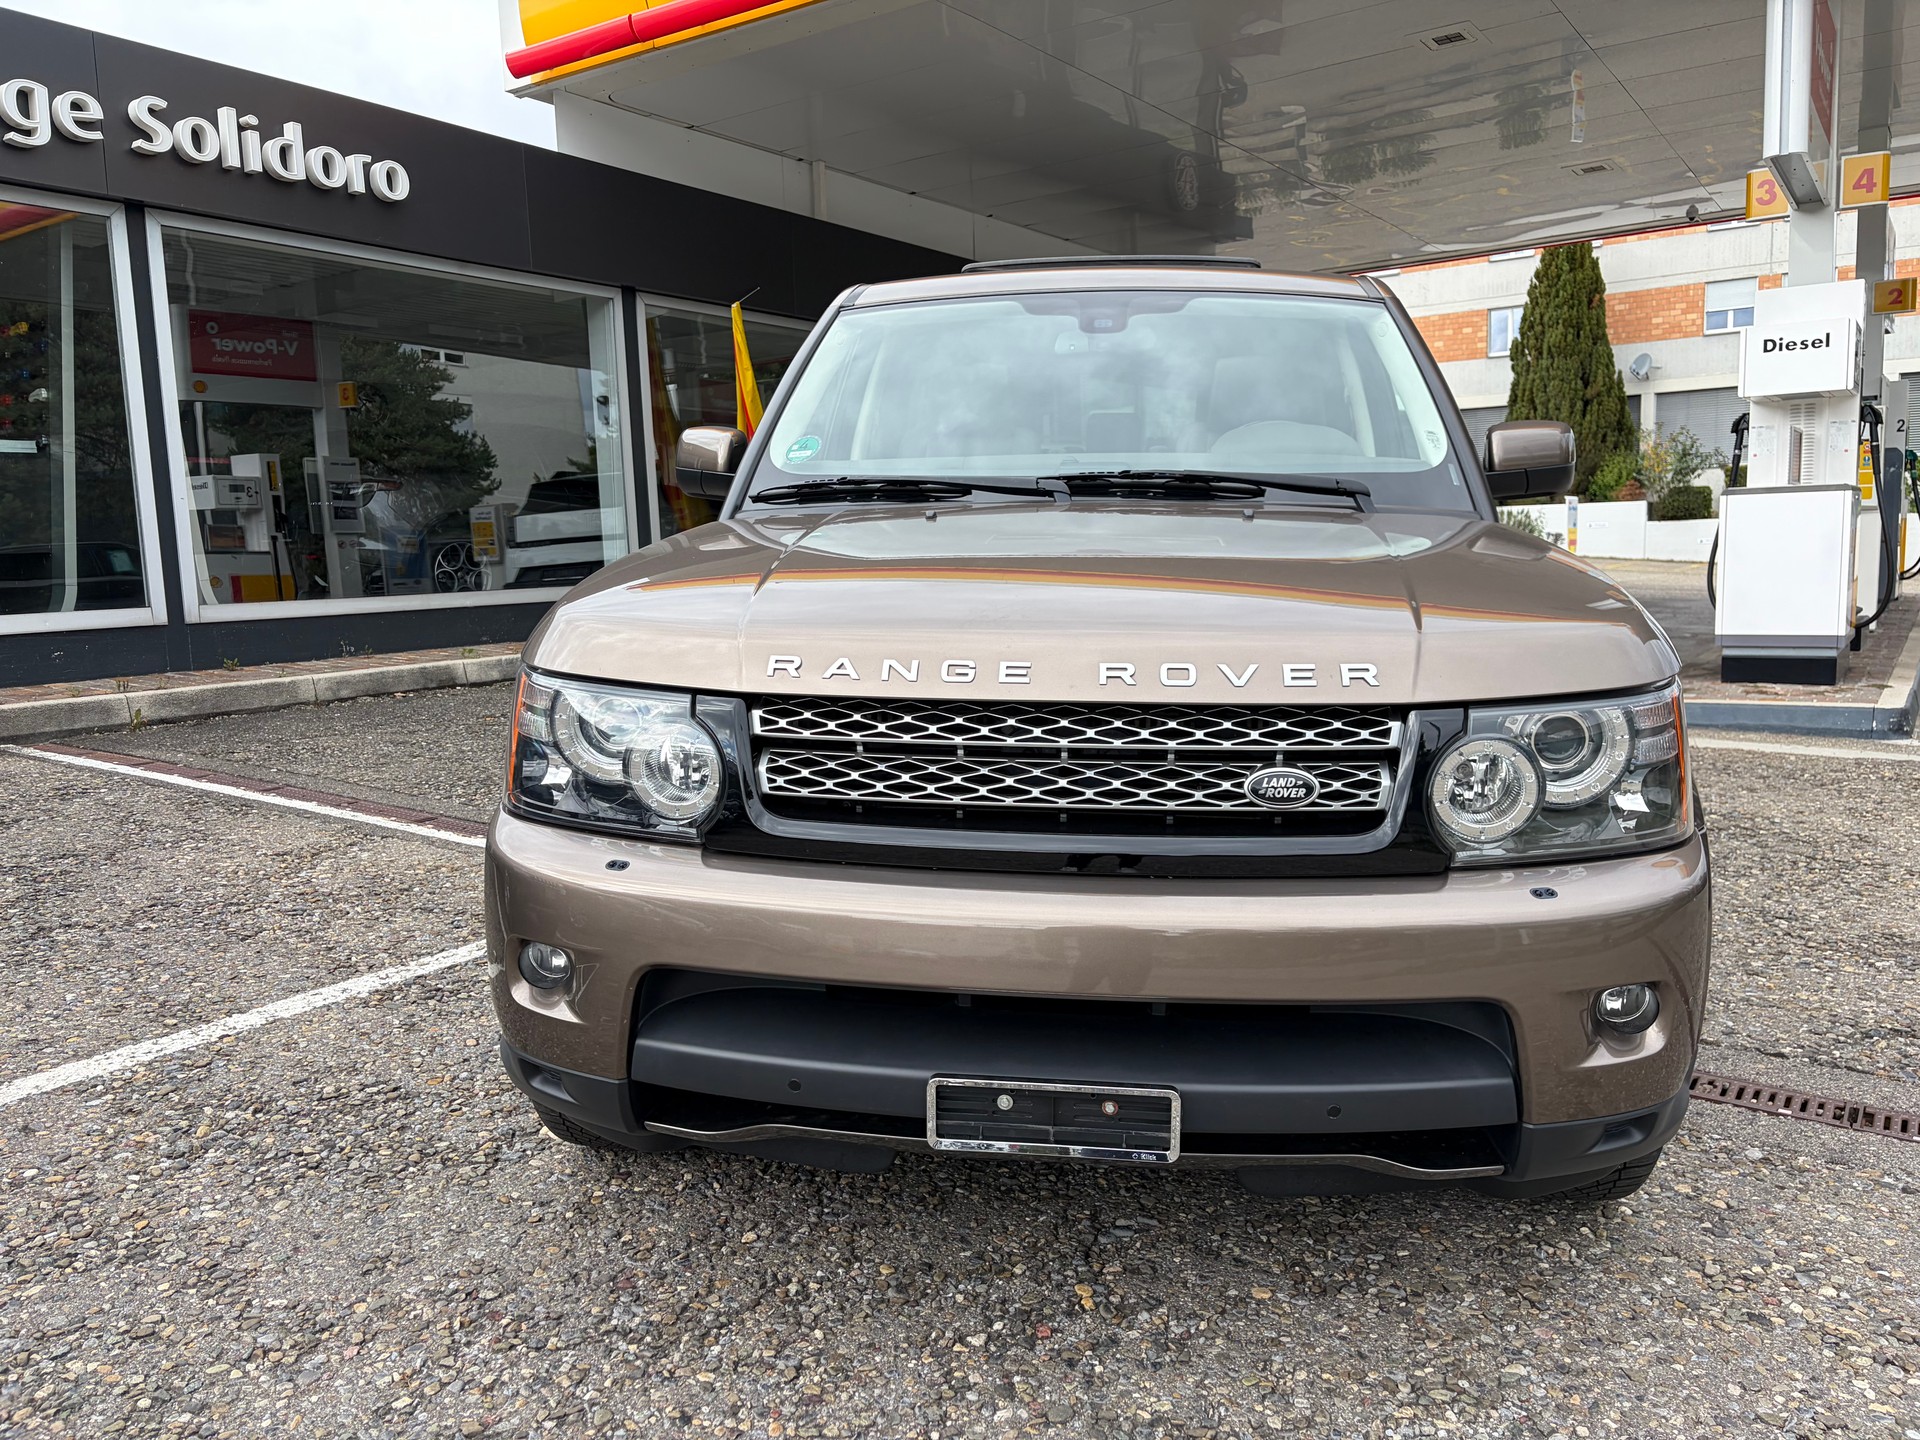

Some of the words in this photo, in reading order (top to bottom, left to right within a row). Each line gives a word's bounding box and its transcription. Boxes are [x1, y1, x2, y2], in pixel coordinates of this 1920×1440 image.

[127, 95, 411, 202] Solidoro
[1852, 167, 1877, 194] 4
[1755, 178, 1778, 206] 3
[1887, 287, 1904, 306] 2
[1762, 332, 1831, 354] Diesel
[1896, 418, 1905, 433] 2
[766, 654, 1032, 684] RANGE
[1098, 662, 1380, 688] ROVER
[1262, 777, 1296, 788] LAND
[1265, 787, 1307, 798] ROVER
